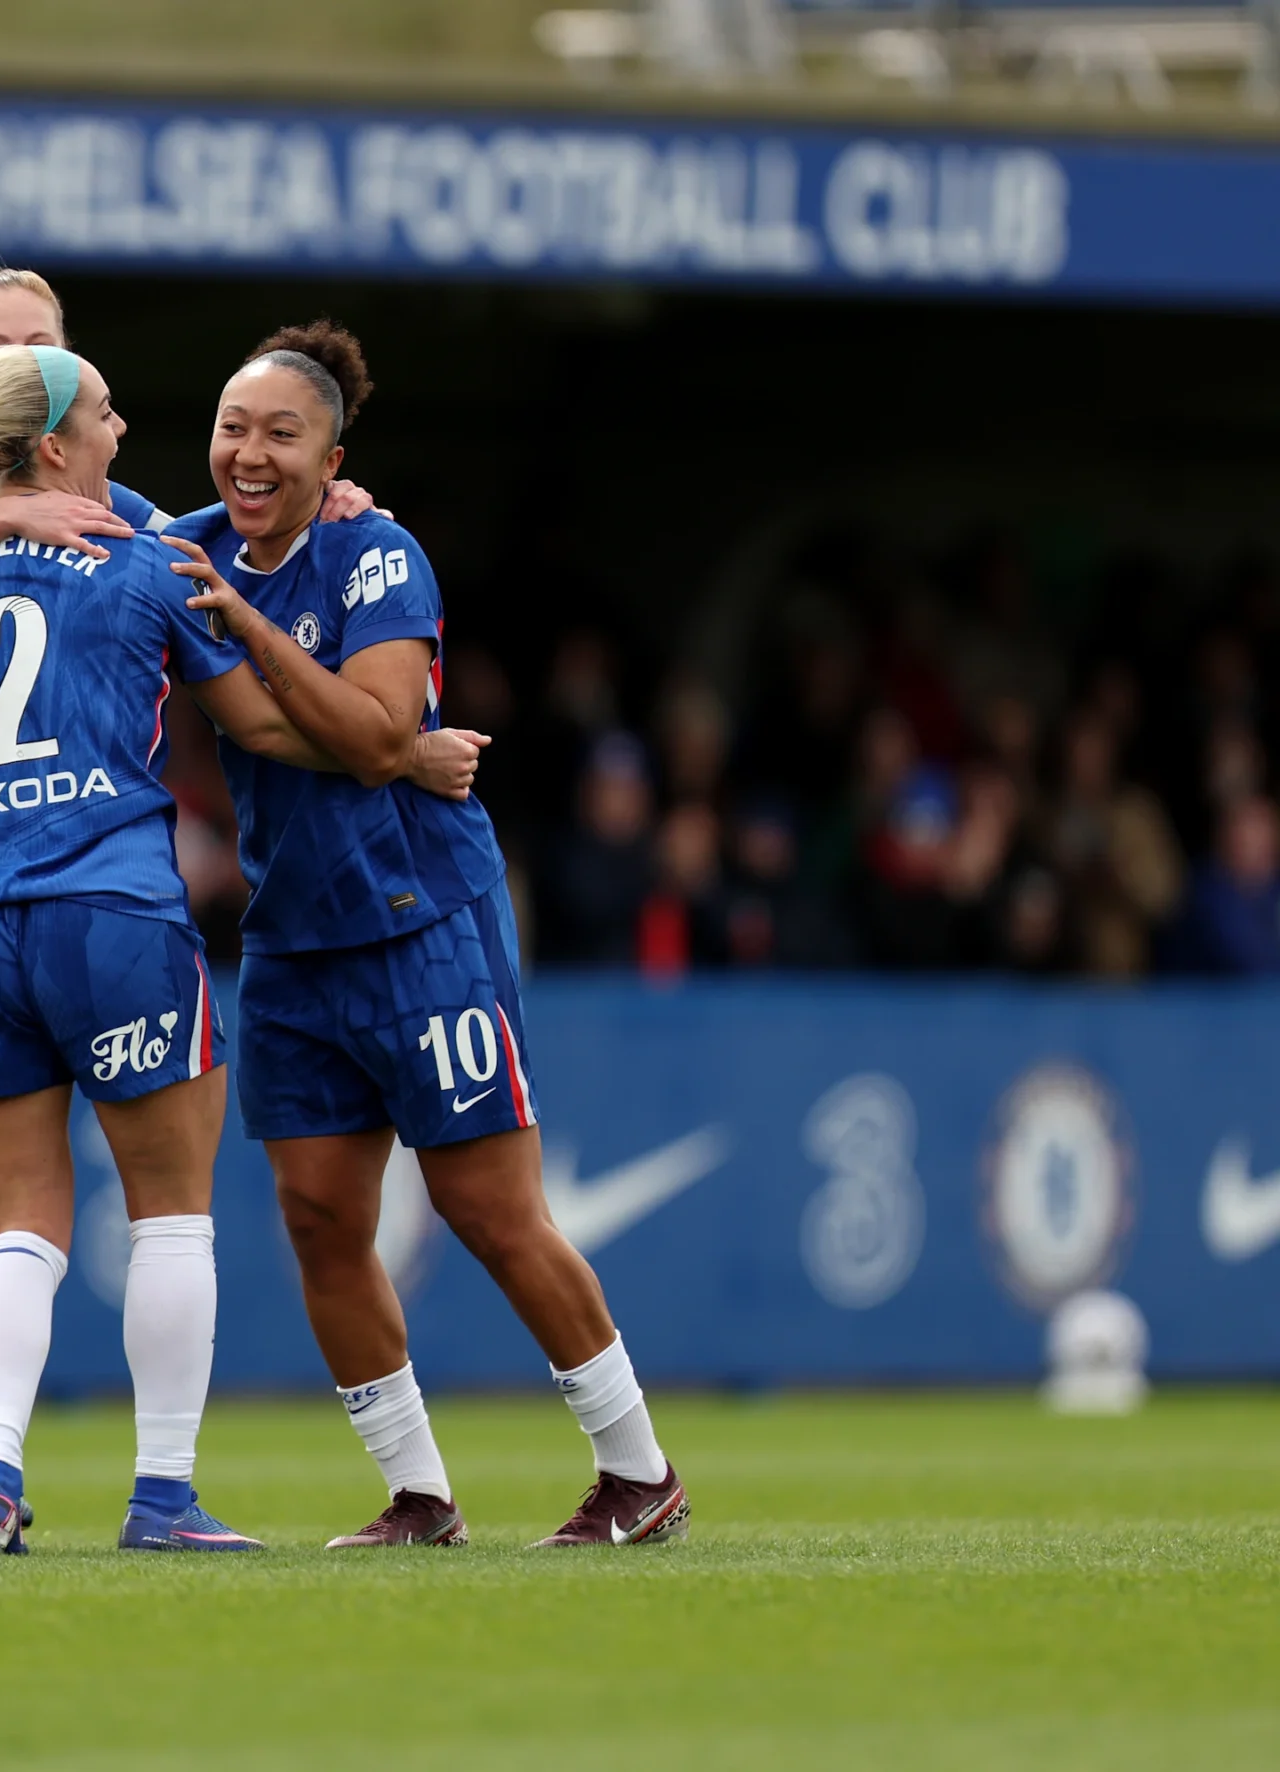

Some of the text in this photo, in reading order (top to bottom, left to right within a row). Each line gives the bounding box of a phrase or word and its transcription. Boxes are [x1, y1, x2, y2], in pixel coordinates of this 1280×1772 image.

[348, 121, 818, 273] FOOTBALL
[825, 140, 1070, 285] CLUB
[91, 1016, 171, 1081] Flo
[419, 1007, 497, 1091] 10
[344, 1386, 380, 1404] CFC
